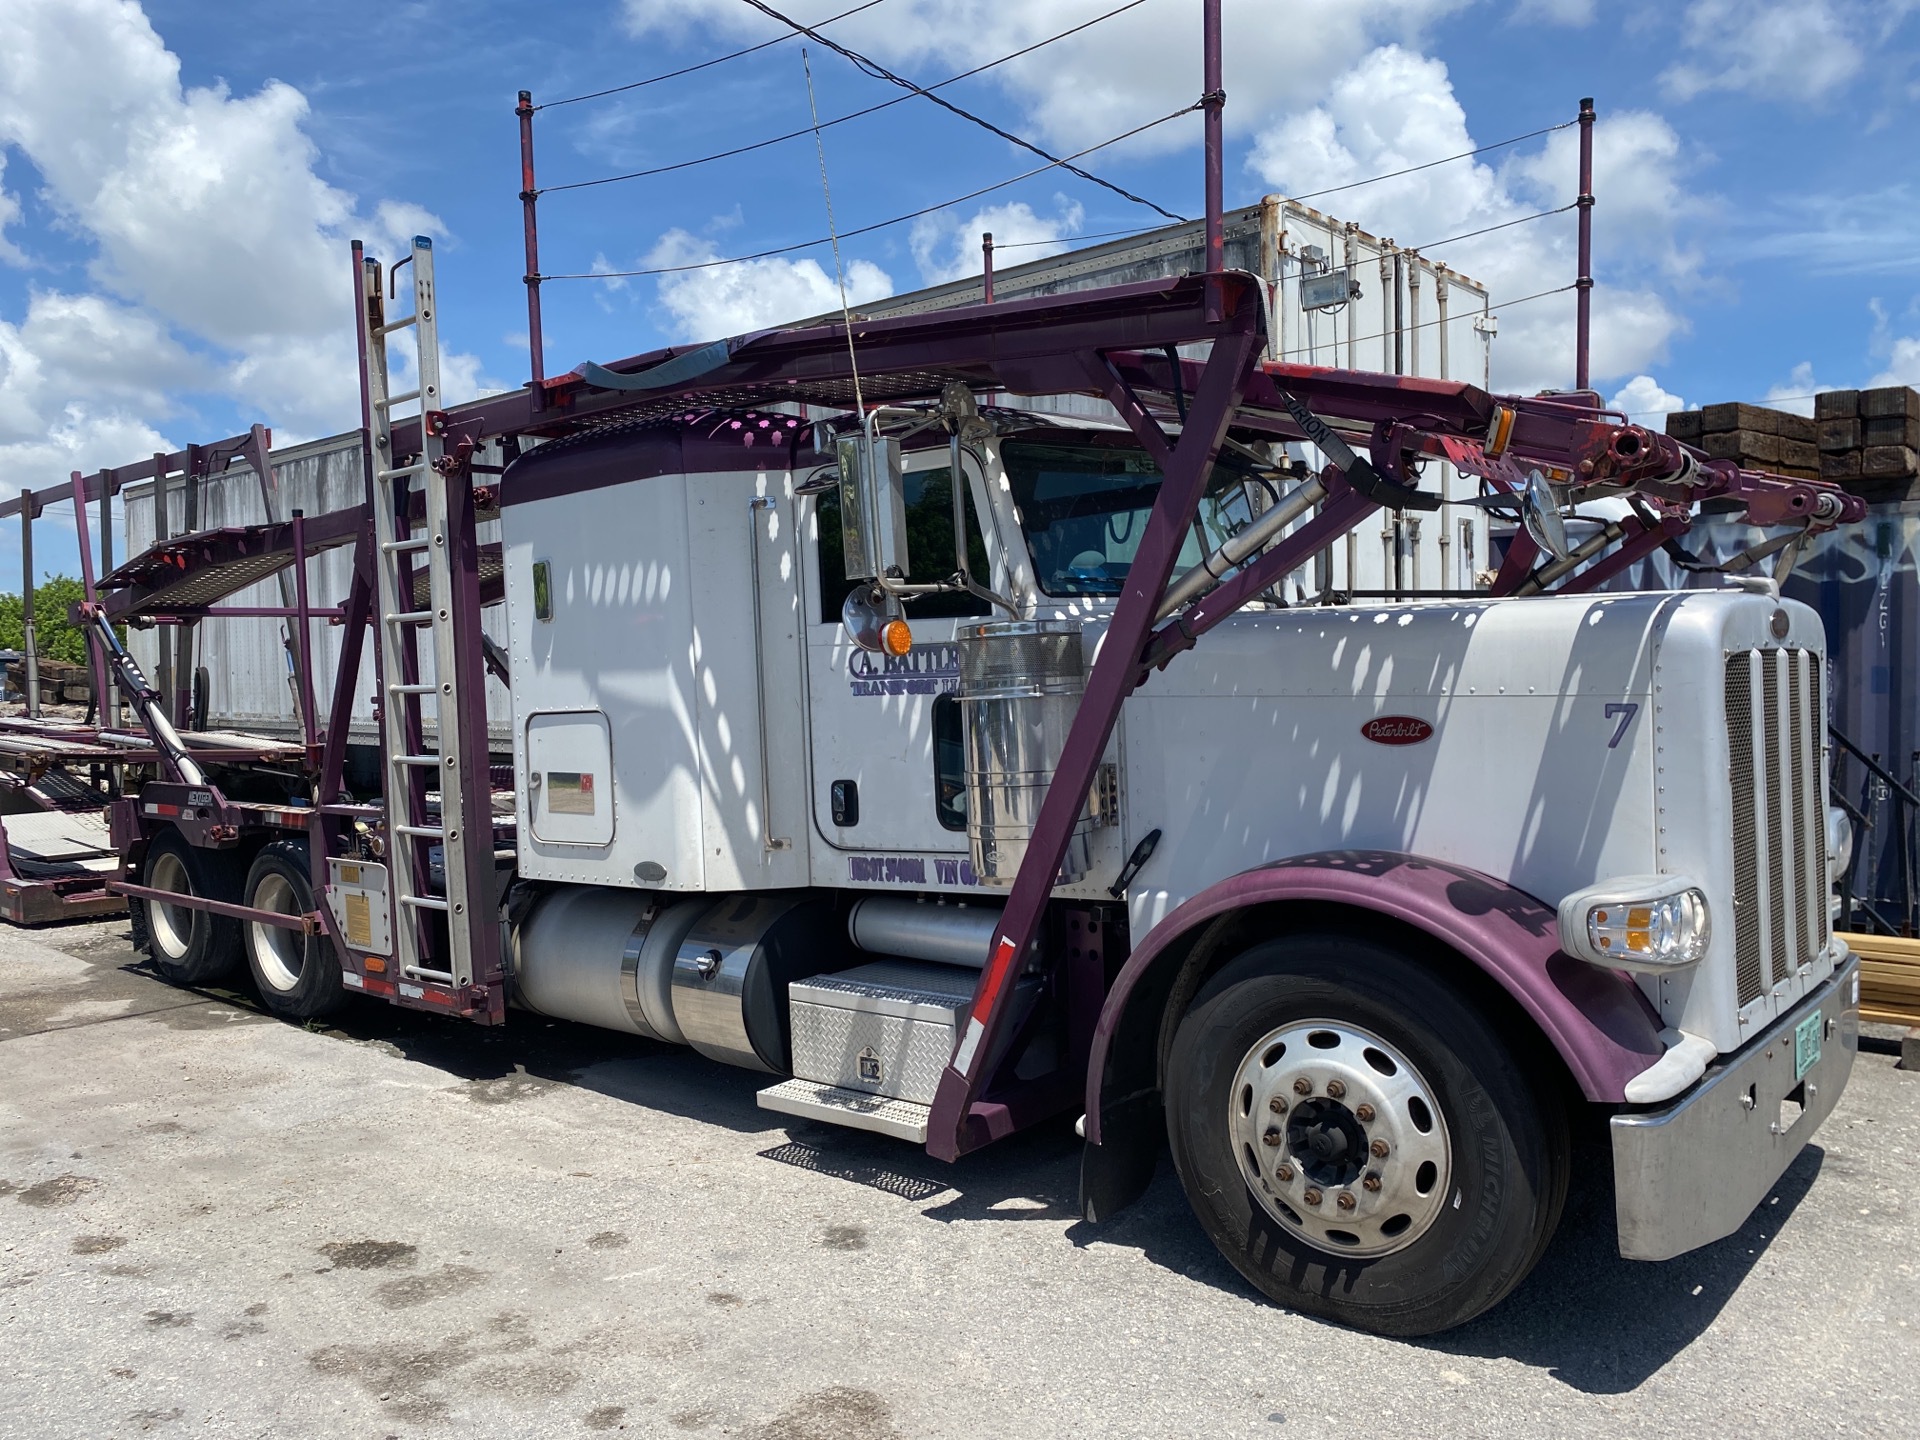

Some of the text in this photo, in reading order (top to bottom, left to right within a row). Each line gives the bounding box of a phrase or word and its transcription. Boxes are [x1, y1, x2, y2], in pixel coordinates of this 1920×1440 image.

[850, 679, 938, 696] TRANSPORT
[1369, 721, 1427, 739] Peterbilt
[1605, 703, 1638, 749] 7
